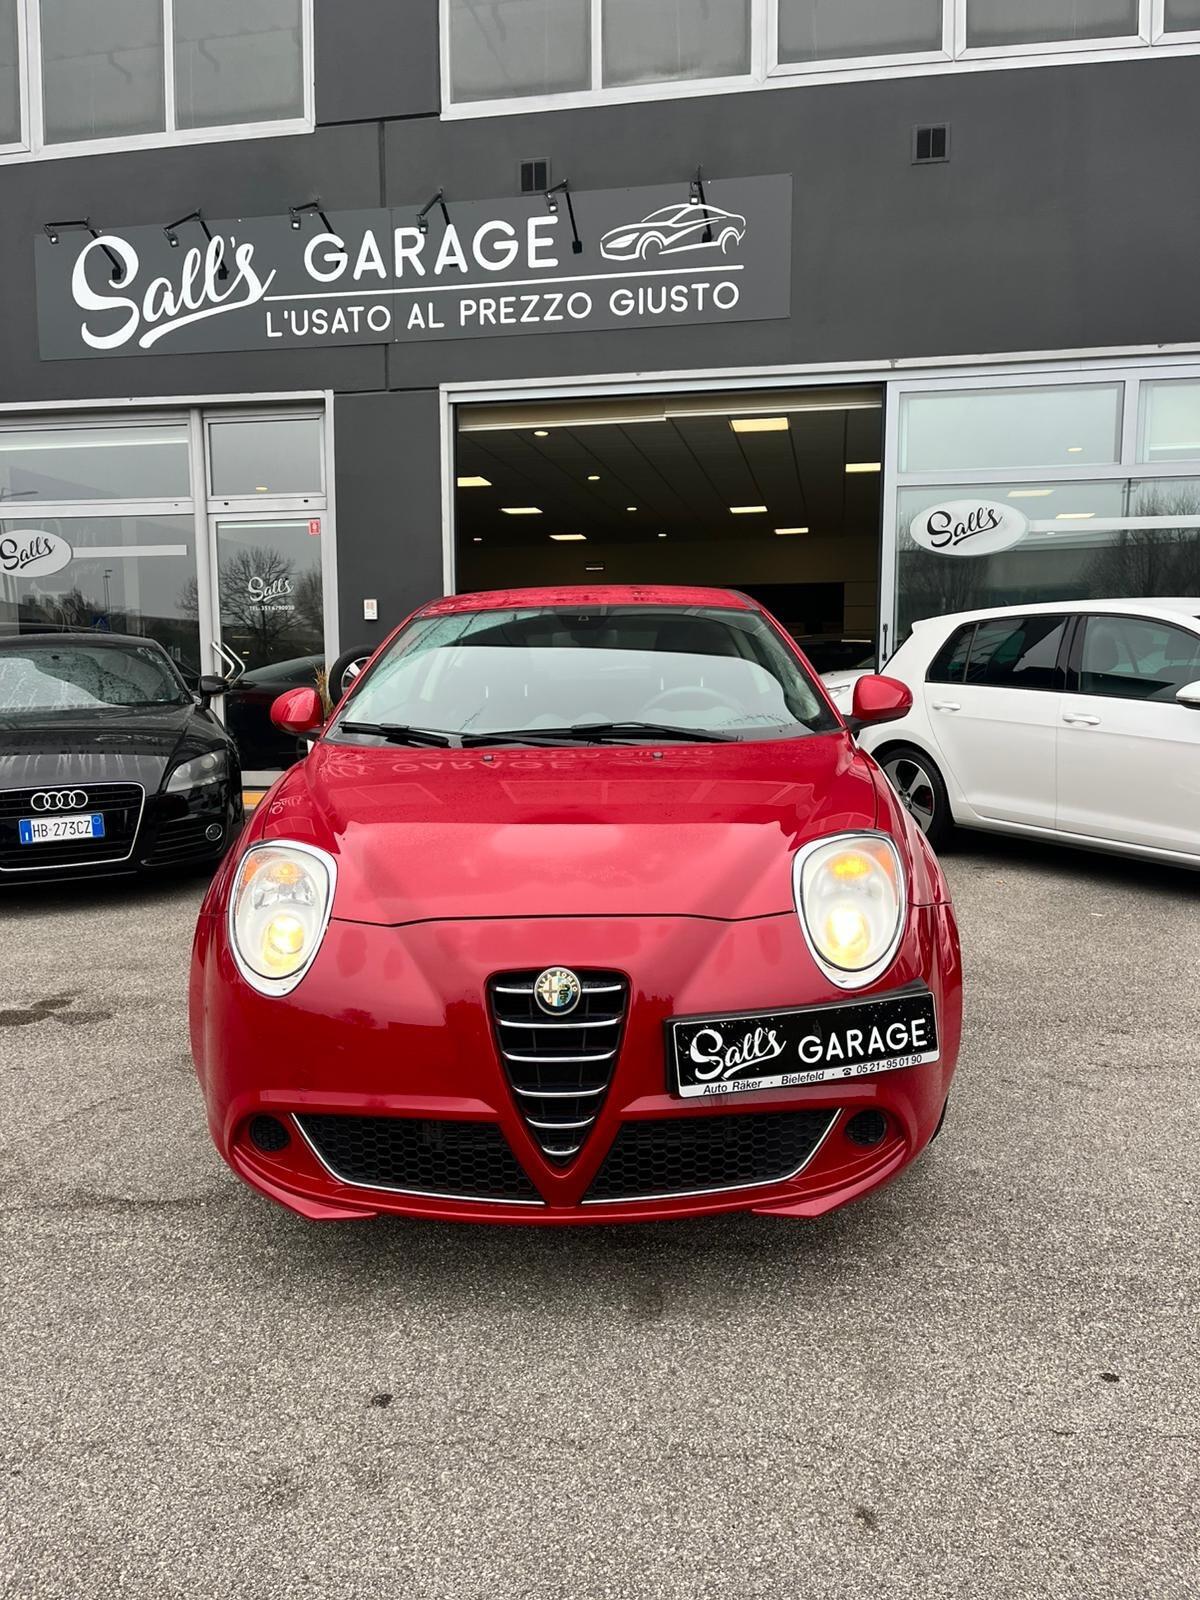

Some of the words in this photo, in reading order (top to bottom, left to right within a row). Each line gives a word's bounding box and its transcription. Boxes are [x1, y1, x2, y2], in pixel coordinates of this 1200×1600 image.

[72, 235, 276, 349] Sall's
[304, 215, 558, 282] GARAGE
[265, 304, 392, 337] L'USATO
[407, 302, 444, 329] AL
[460, 291, 592, 326] PREZZO
[609, 281, 740, 316] GIUSTO
[927, 507, 1002, 548] Sall's
[0, 536, 55, 570] Sall's
[690, 1027, 787, 1080] Sall's
[798, 1018, 928, 1064] GARAGE
[703, 1082, 728, 1095] Auto
[732, 1078, 763, 1091] Räker
[781, 1070, 825, 1085] Bielefeld
